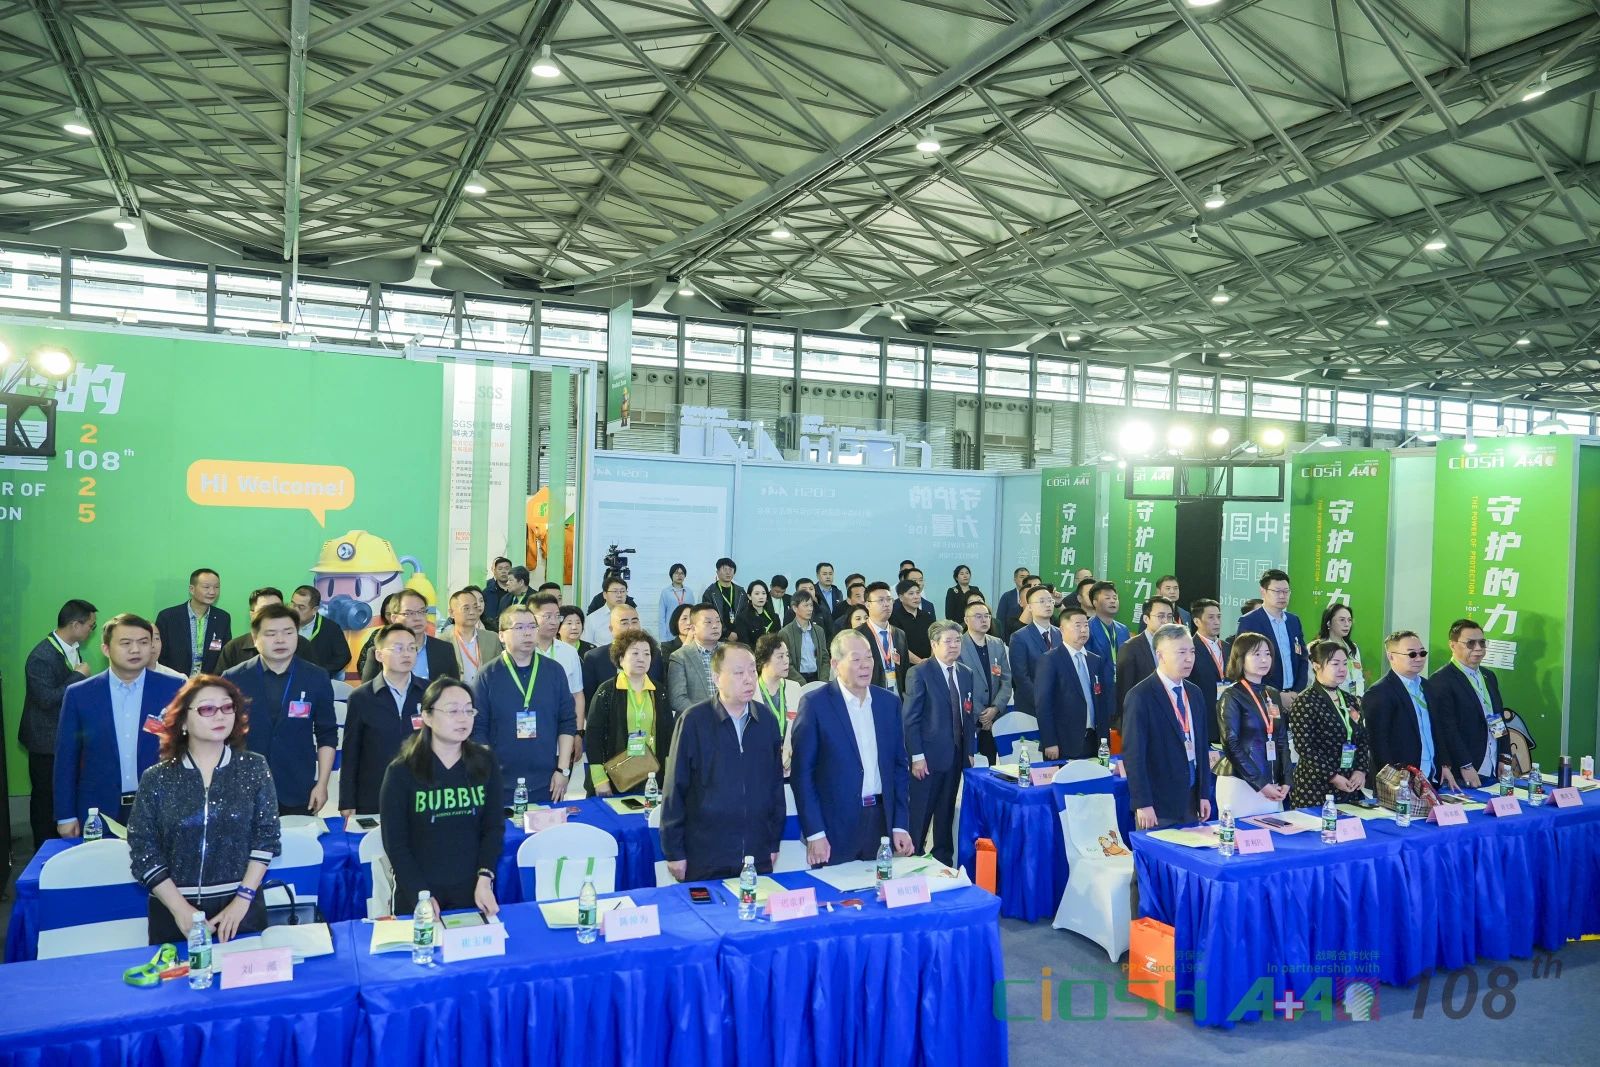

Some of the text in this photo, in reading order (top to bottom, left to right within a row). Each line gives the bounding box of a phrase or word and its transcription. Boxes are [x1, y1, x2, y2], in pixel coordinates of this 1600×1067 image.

[79, 423, 98, 444] 2
[20, 482, 46, 497] OF
[77, 476, 97, 497] 2
[200, 472, 346, 497] Hi Welcome!
[77, 503, 97, 524] 5
[1060, 502, 1077, 598] 守护的力
[1480, 495, 1522, 671] 守护的力量
